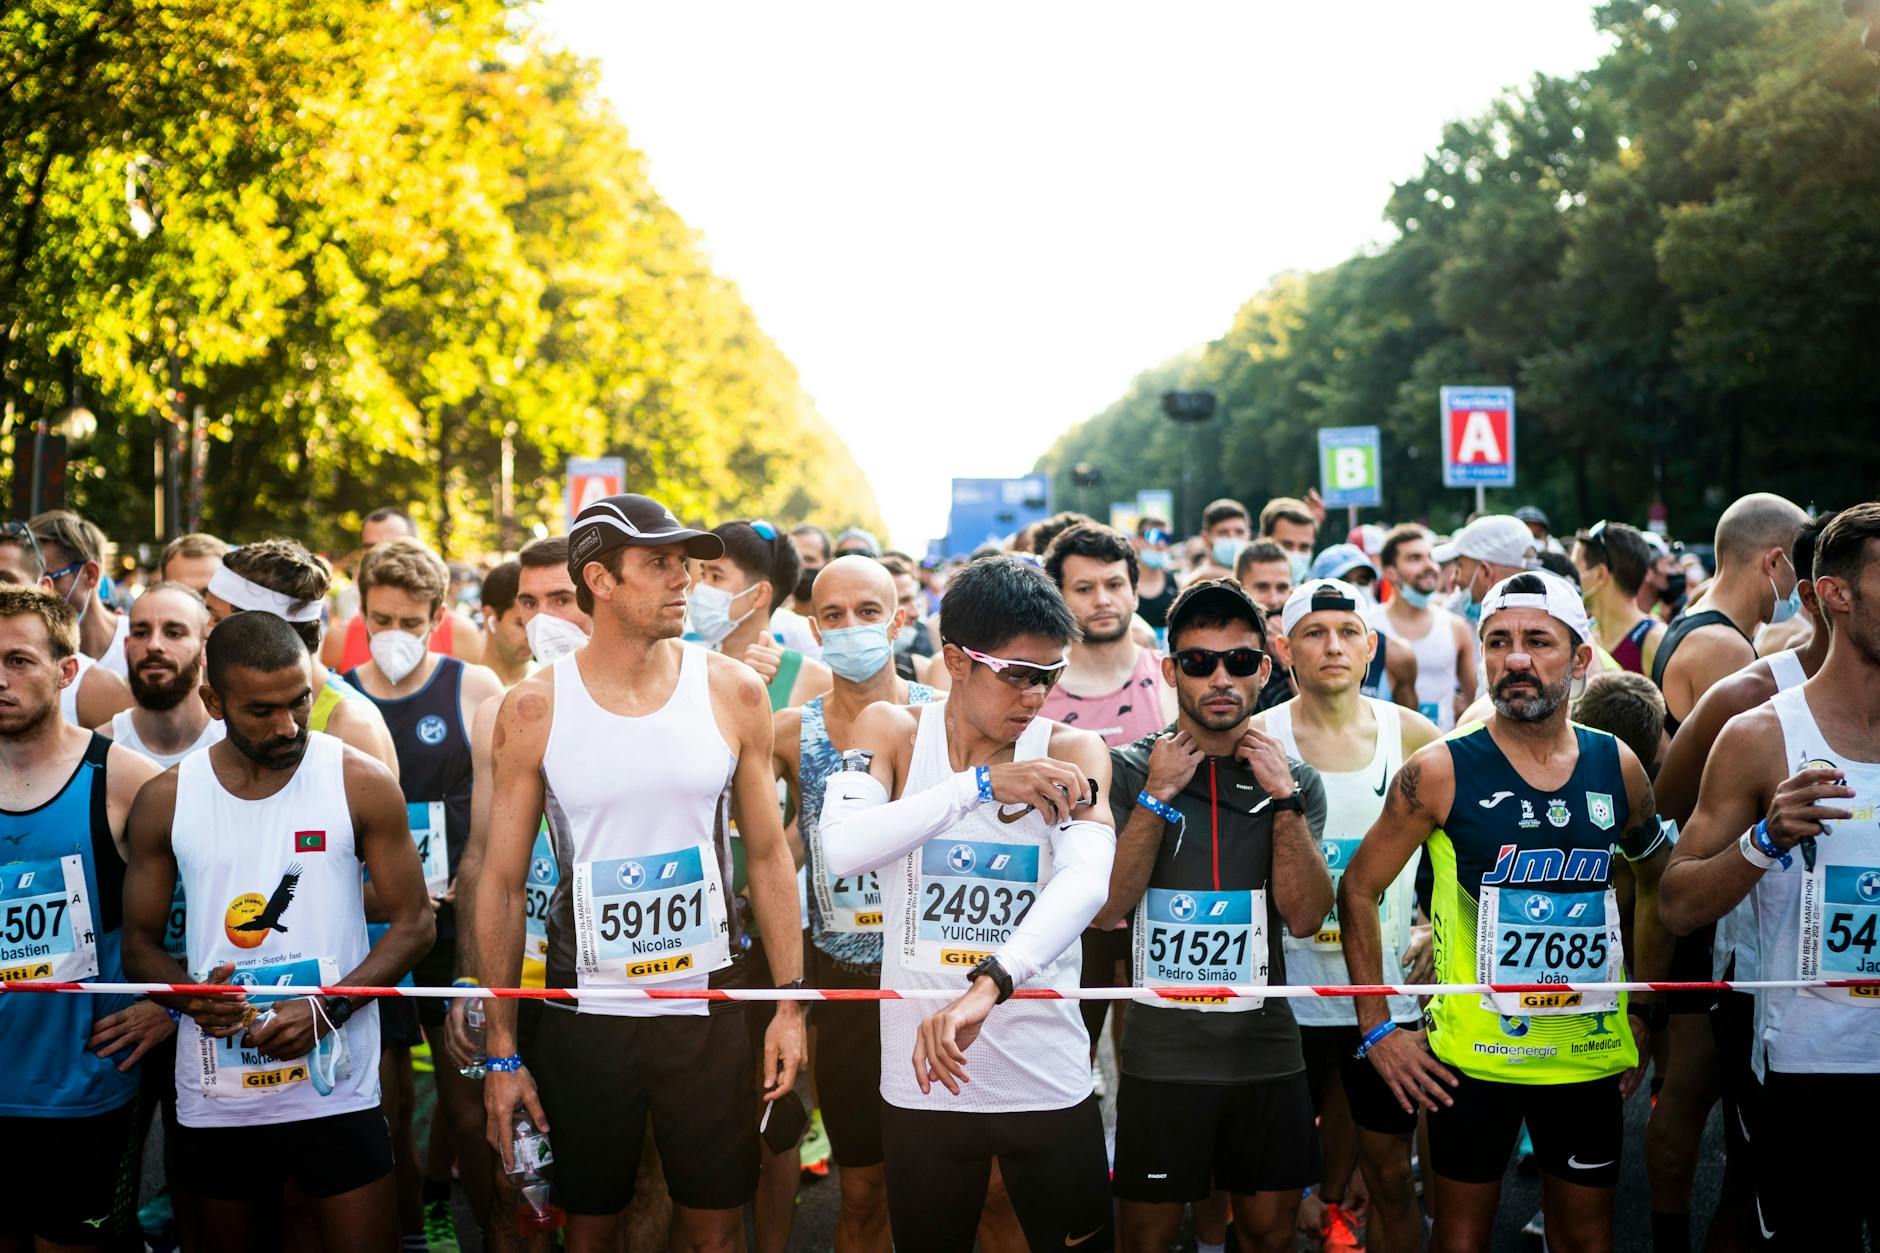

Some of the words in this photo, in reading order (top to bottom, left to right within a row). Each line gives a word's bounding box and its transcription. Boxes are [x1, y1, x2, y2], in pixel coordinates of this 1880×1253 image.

[1457, 411, 1502, 464] A
[1335, 447, 1368, 489] B
[708, 882, 717, 894] A
[72, 894, 81, 904] A
[923, 882, 1036, 926] 24932
[0, 899, 67, 944] 507
[600, 888, 702, 942] 59161
[1803, 879, 1813, 955] BERLIN-MARATHON
[1254, 927, 1262, 937] A
[1479, 900, 1489, 970] BERLIN-MARATHON
[1610, 931, 1618, 943] A
[1827, 912, 1878, 955] 54
[632, 937, 682, 954] Nicolas
[1149, 928, 1248, 966] 51521
[1500, 930, 1607, 969] 27685
[262, 953, 288, 966] Supply
[289, 951, 302, 960] fast
[1810, 939, 1818, 976] September
[0, 967, 27, 981] iti
[631, 961, 669, 975] Giti
[1158, 965, 1194, 980] Pedro
[1198, 968, 1237, 981] Simão
[1536, 971, 1569, 985] João
[1524, 995, 1559, 1007] Giti
[208, 1040, 216, 1075] September
[1473, 1042, 1558, 1060] maiaenergia
[247, 1073, 281, 1086] Giti
